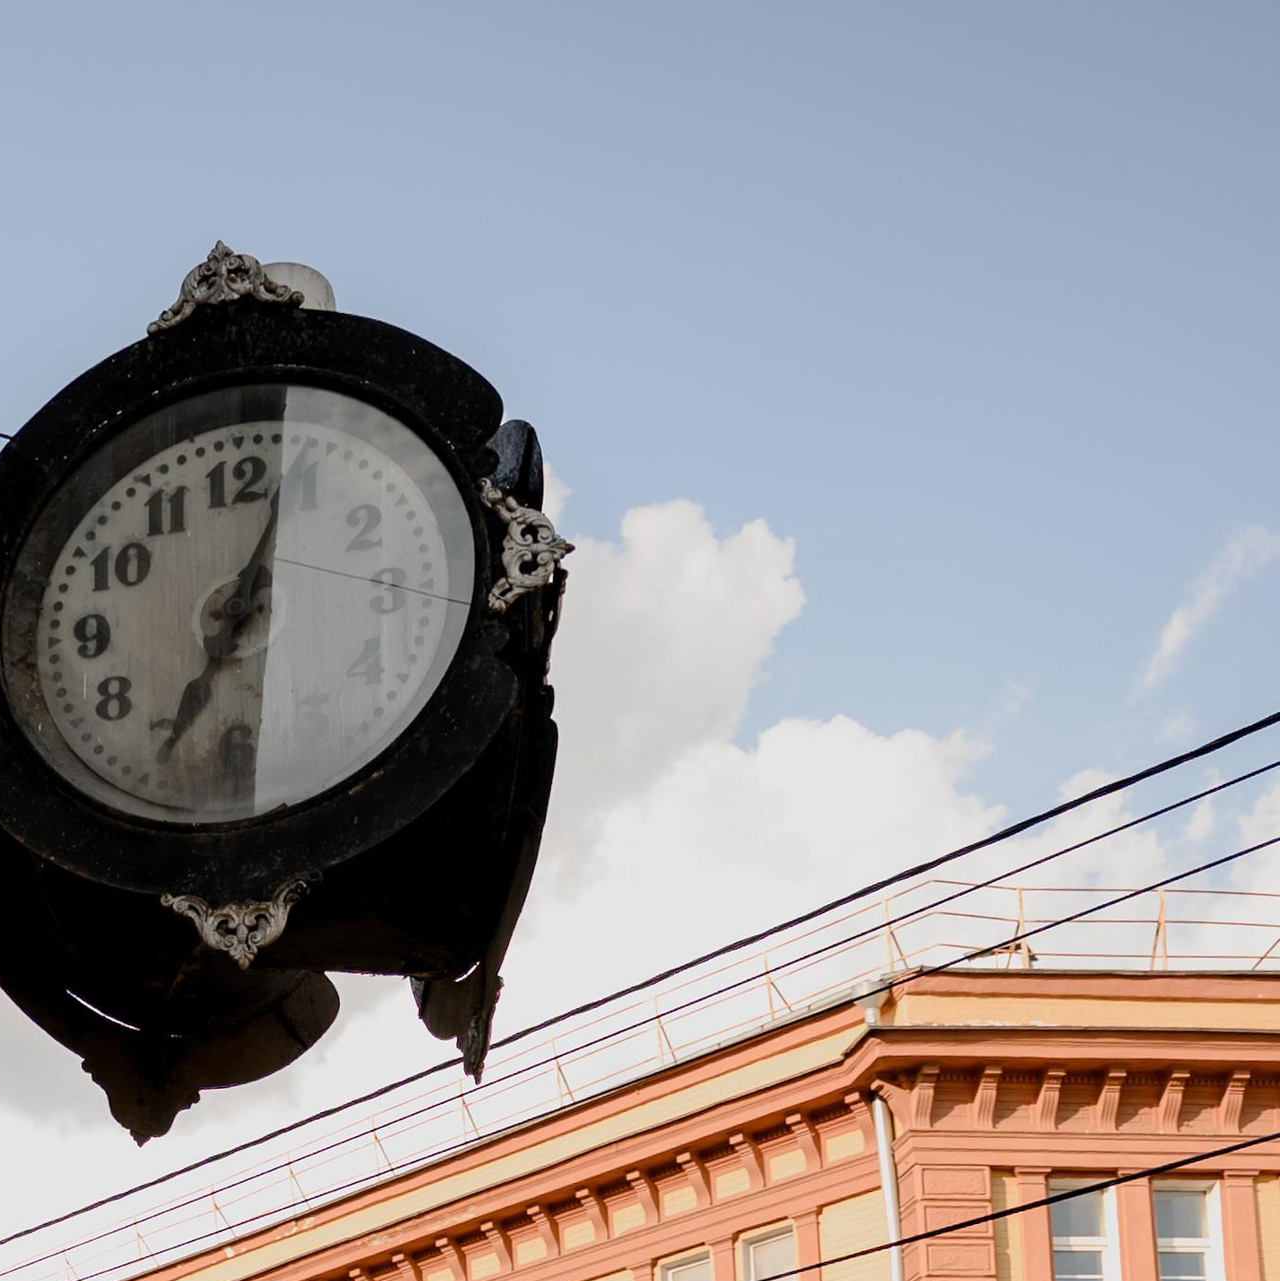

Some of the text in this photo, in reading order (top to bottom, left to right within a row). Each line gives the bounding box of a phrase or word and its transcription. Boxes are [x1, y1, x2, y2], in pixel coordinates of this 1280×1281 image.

[206, 455, 268, 510] 12
[144, 485, 190, 538] 11
[345, 504, 383, 554] 2
[89, 542, 152, 593] 10
[368, 567, 408, 615] 3
[72, 613, 111, 660] 9
[345, 637, 386, 687] 4
[95, 675, 133, 722] 8
